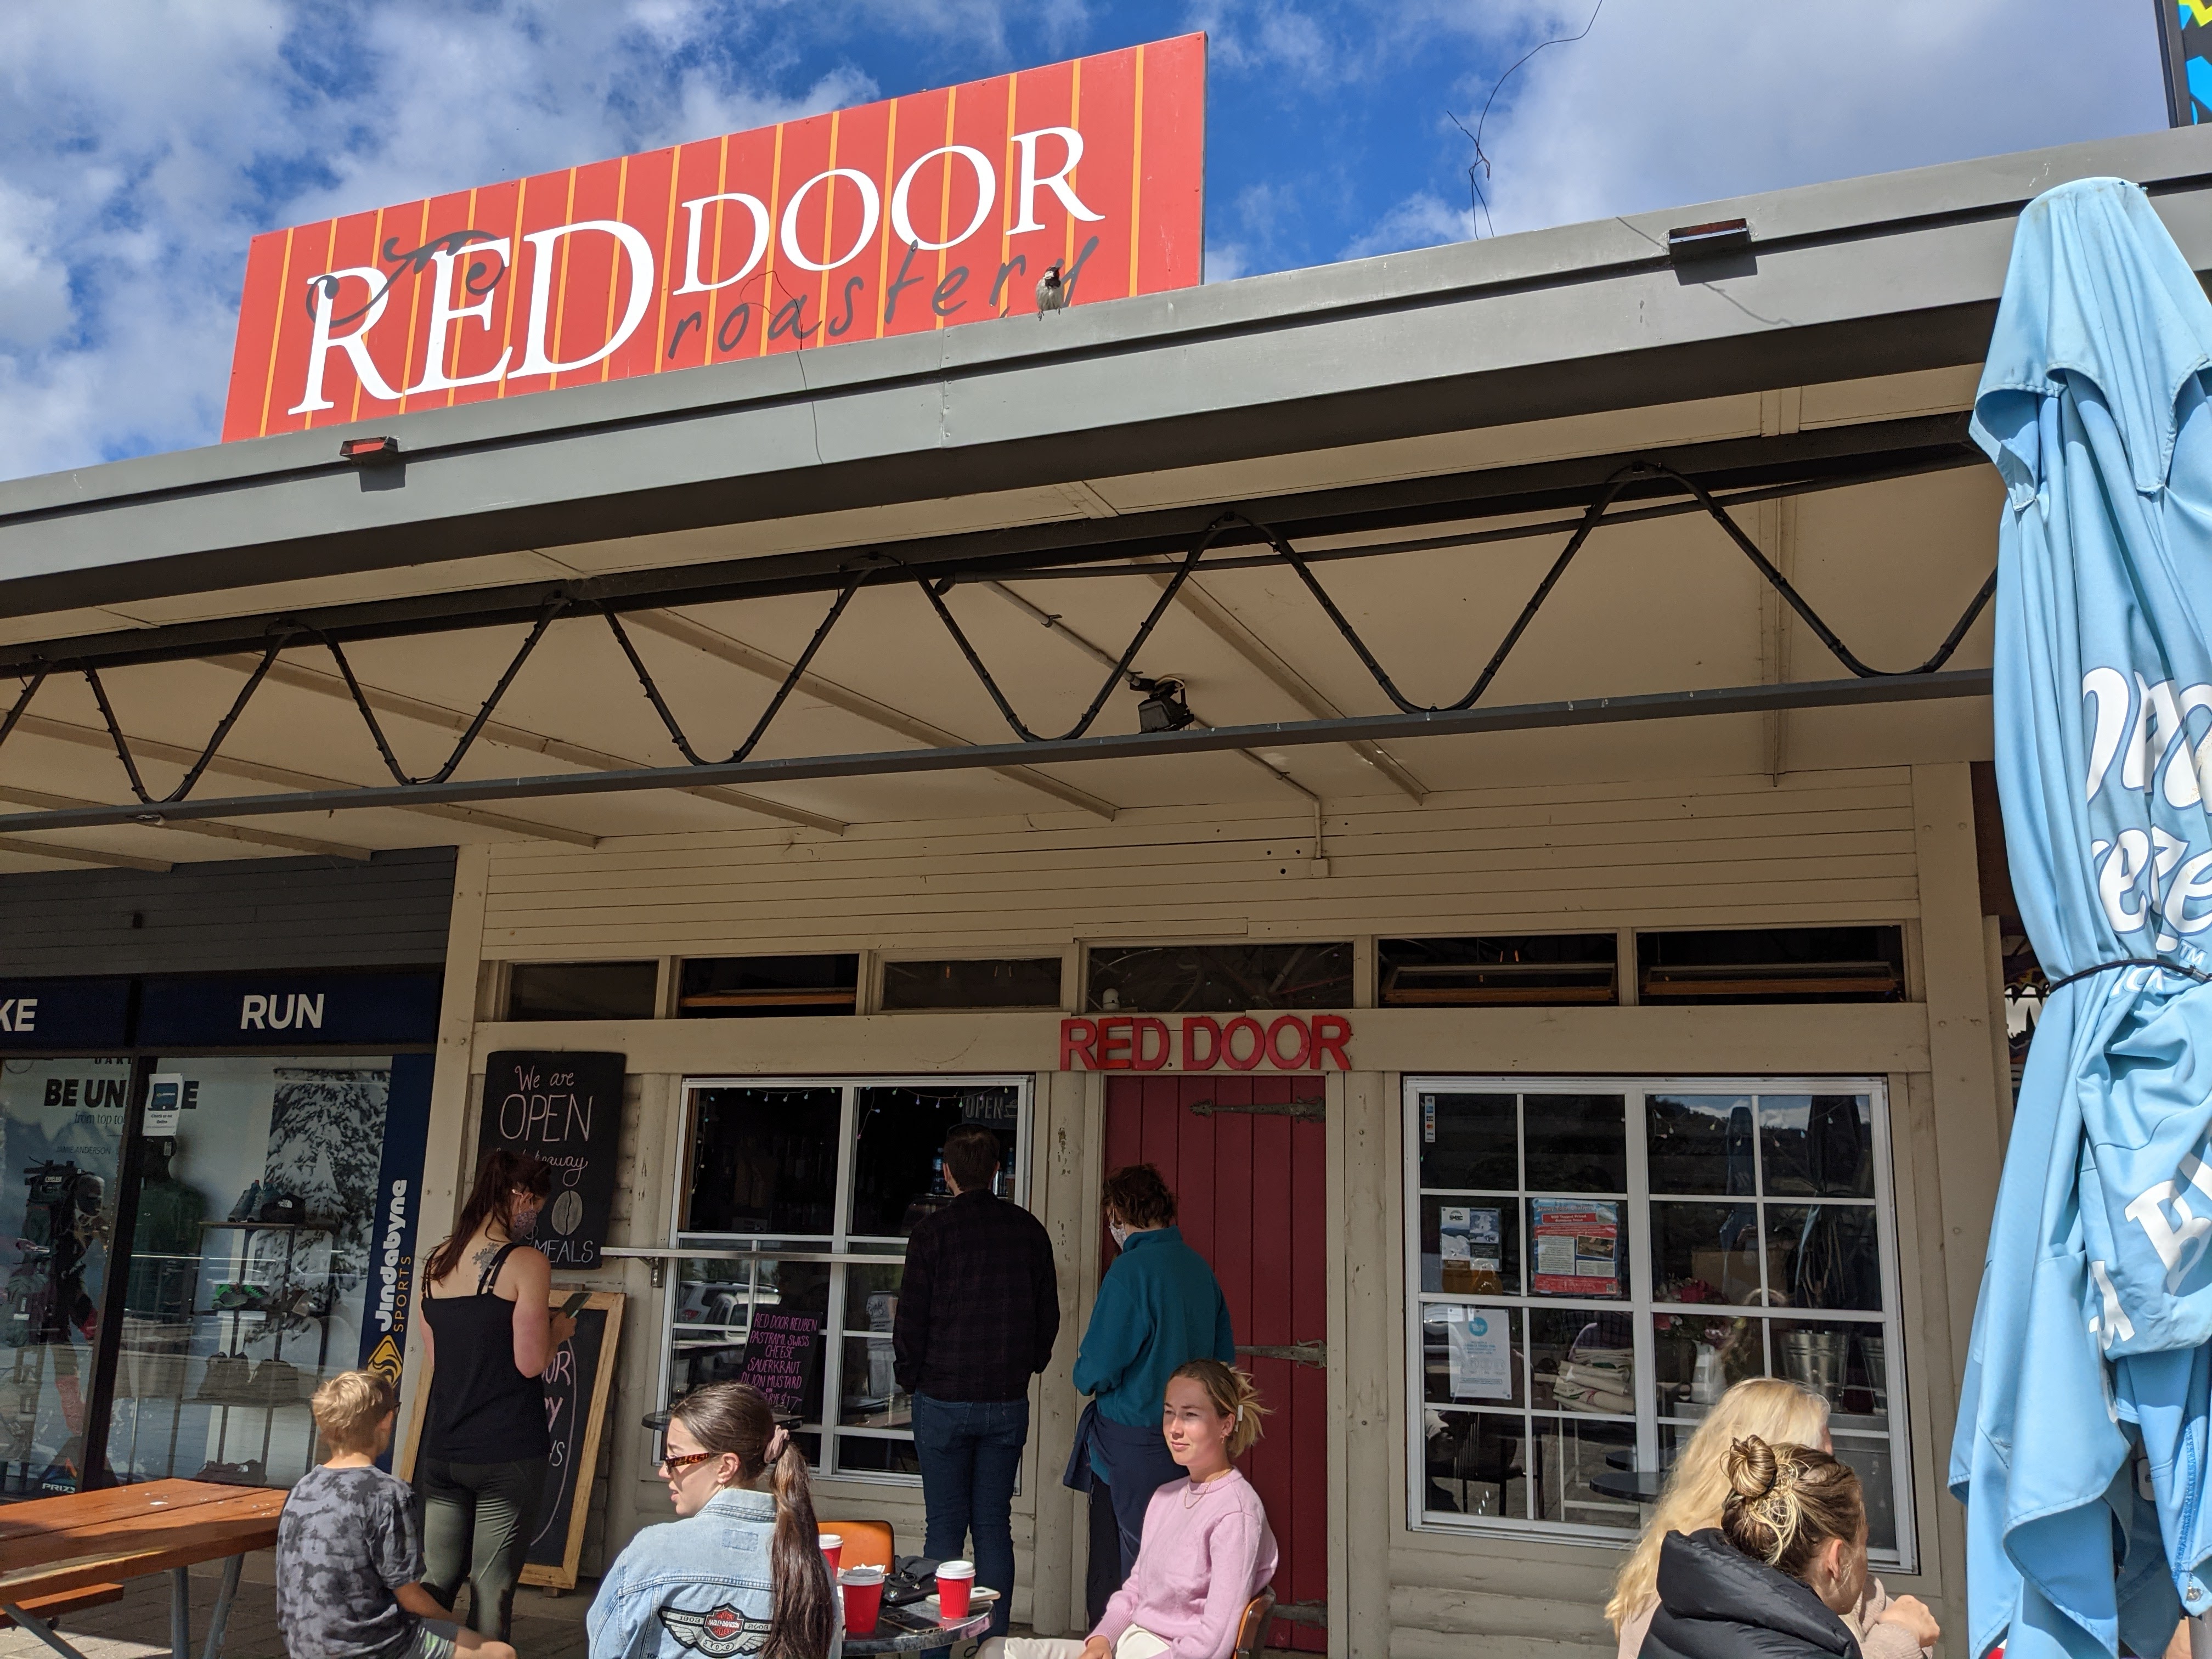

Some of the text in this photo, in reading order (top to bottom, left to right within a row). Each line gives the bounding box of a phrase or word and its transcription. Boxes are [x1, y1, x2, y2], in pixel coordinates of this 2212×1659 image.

[287, 126, 1106, 415] RED DOOR
[240, 993, 324, 1030] RUN
[1060, 1015, 1352, 1071] RED DOOR
[515, 1065, 575, 1092] We are
[44, 1079, 80, 1107] BE
[499, 1093, 593, 1142] OPEN
[965, 1096, 1005, 1119] OPEN
[75, 1111, 94, 1124] from
[98, 1114, 112, 1129] top
[76, 1146, 111, 1154] ANDERSON
[375, 1180, 407, 1332] Jindabyne
[534, 1239, 594, 1263] MEALS
[393, 1256, 411, 1333] SPORTS
[754, 1313, 818, 1332] RED DOOR REUBEN
[765, 1345, 795, 1359] CHEESE
[787, 1335, 809, 1347] SWISS
[747, 1357, 802, 1374] SAUERKRAUT
[741, 1371, 802, 1390] DIJON MUSTARD
[679, 1615, 701, 1623] 1903
